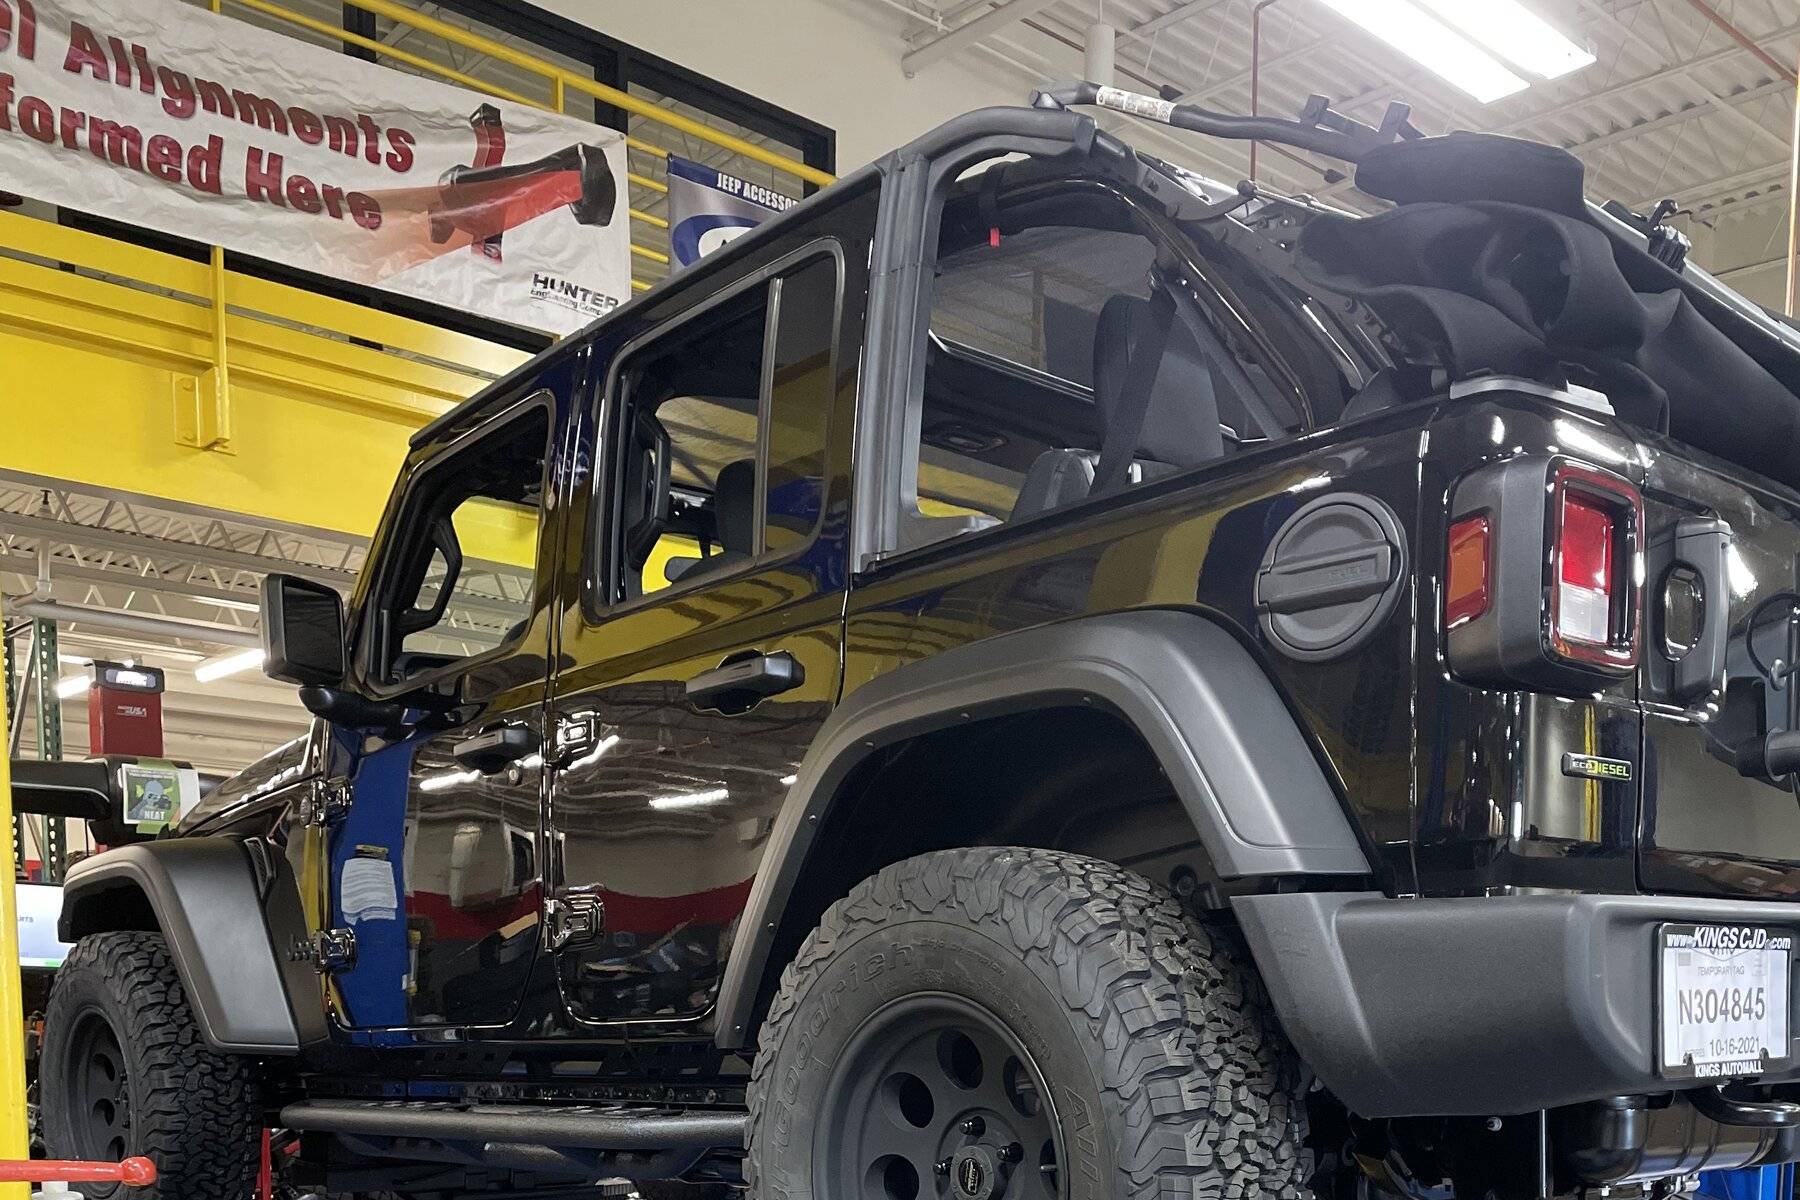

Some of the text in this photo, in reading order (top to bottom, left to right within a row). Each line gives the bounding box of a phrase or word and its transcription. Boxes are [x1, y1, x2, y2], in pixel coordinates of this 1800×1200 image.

[63, 20, 416, 173] Alignments
[246, 146, 382, 231] Here
[716, 172, 742, 194] JEEP
[533, 273, 619, 309] HUNTER
[1680, 987, 1765, 1024] N304845
[1710, 1036, 1760, 1056] 10-16-2021
[1695, 1060, 1763, 1077] KINGS AUTOMALL
